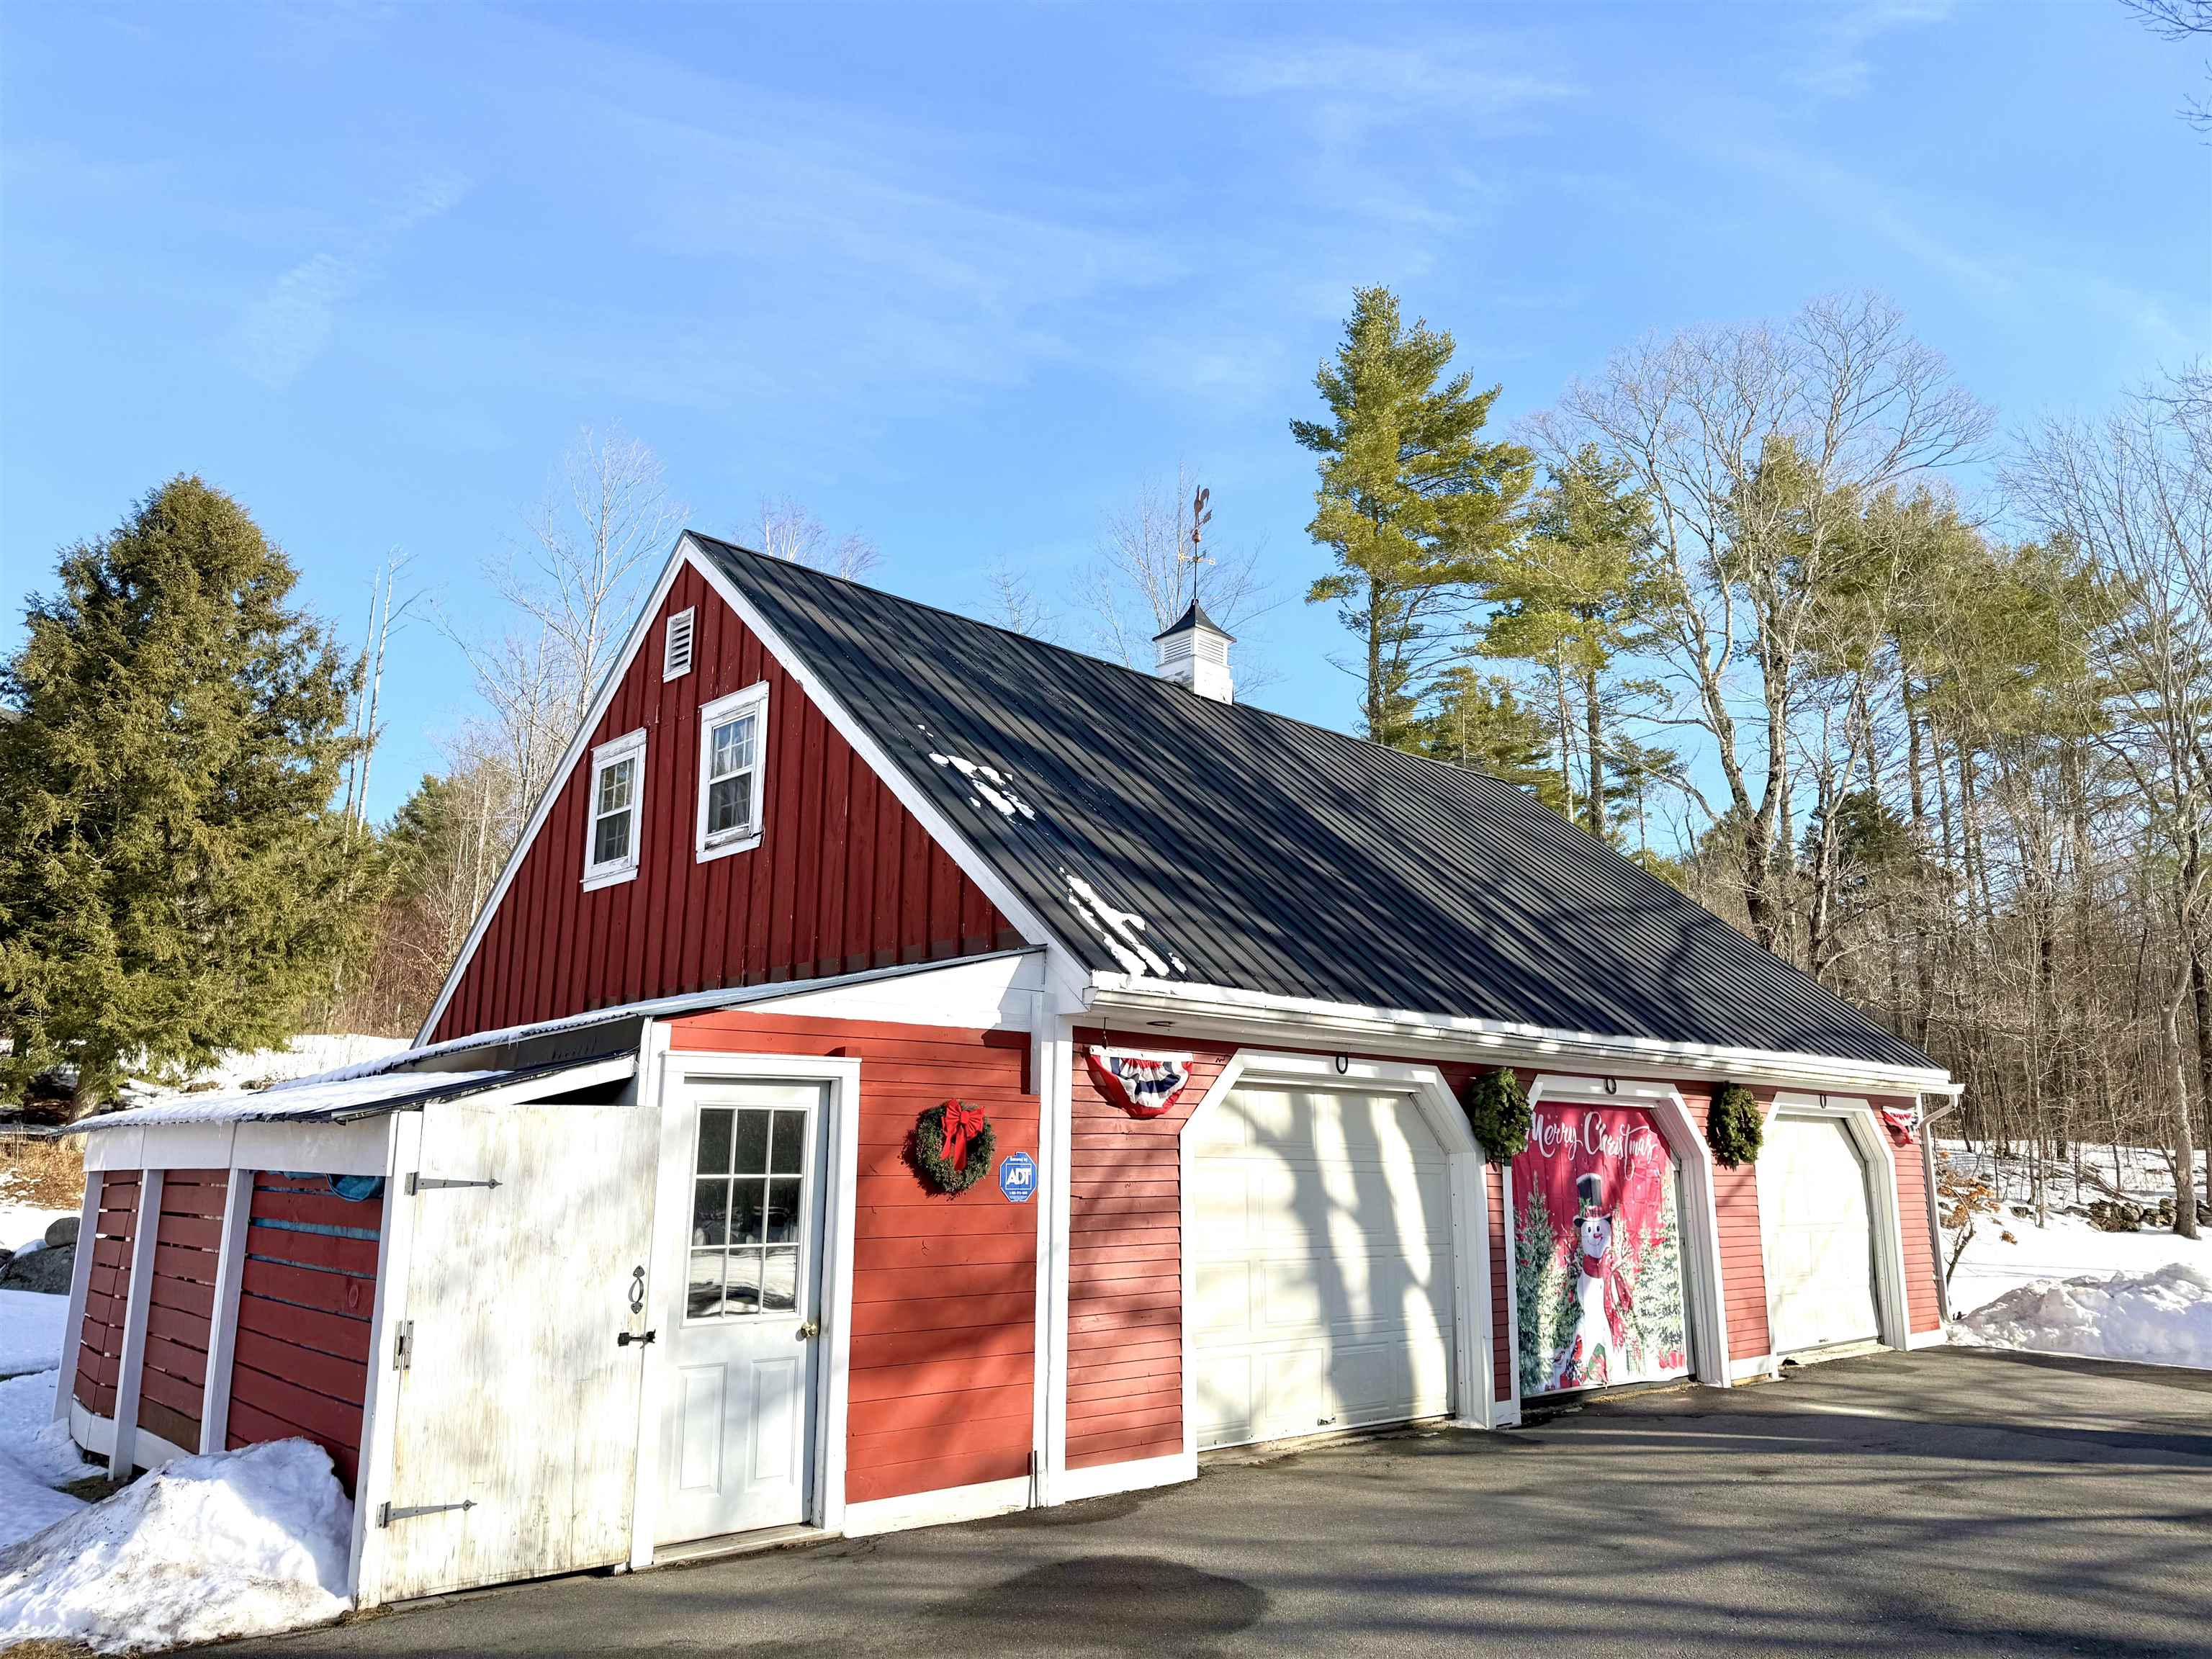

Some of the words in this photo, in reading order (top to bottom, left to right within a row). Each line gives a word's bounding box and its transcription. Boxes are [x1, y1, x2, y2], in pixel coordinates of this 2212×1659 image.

[1524, 1111, 1583, 1161] Merry
[1584, 1110, 1658, 1181] Christmas
[1007, 1168, 1030, 1185] ADT
